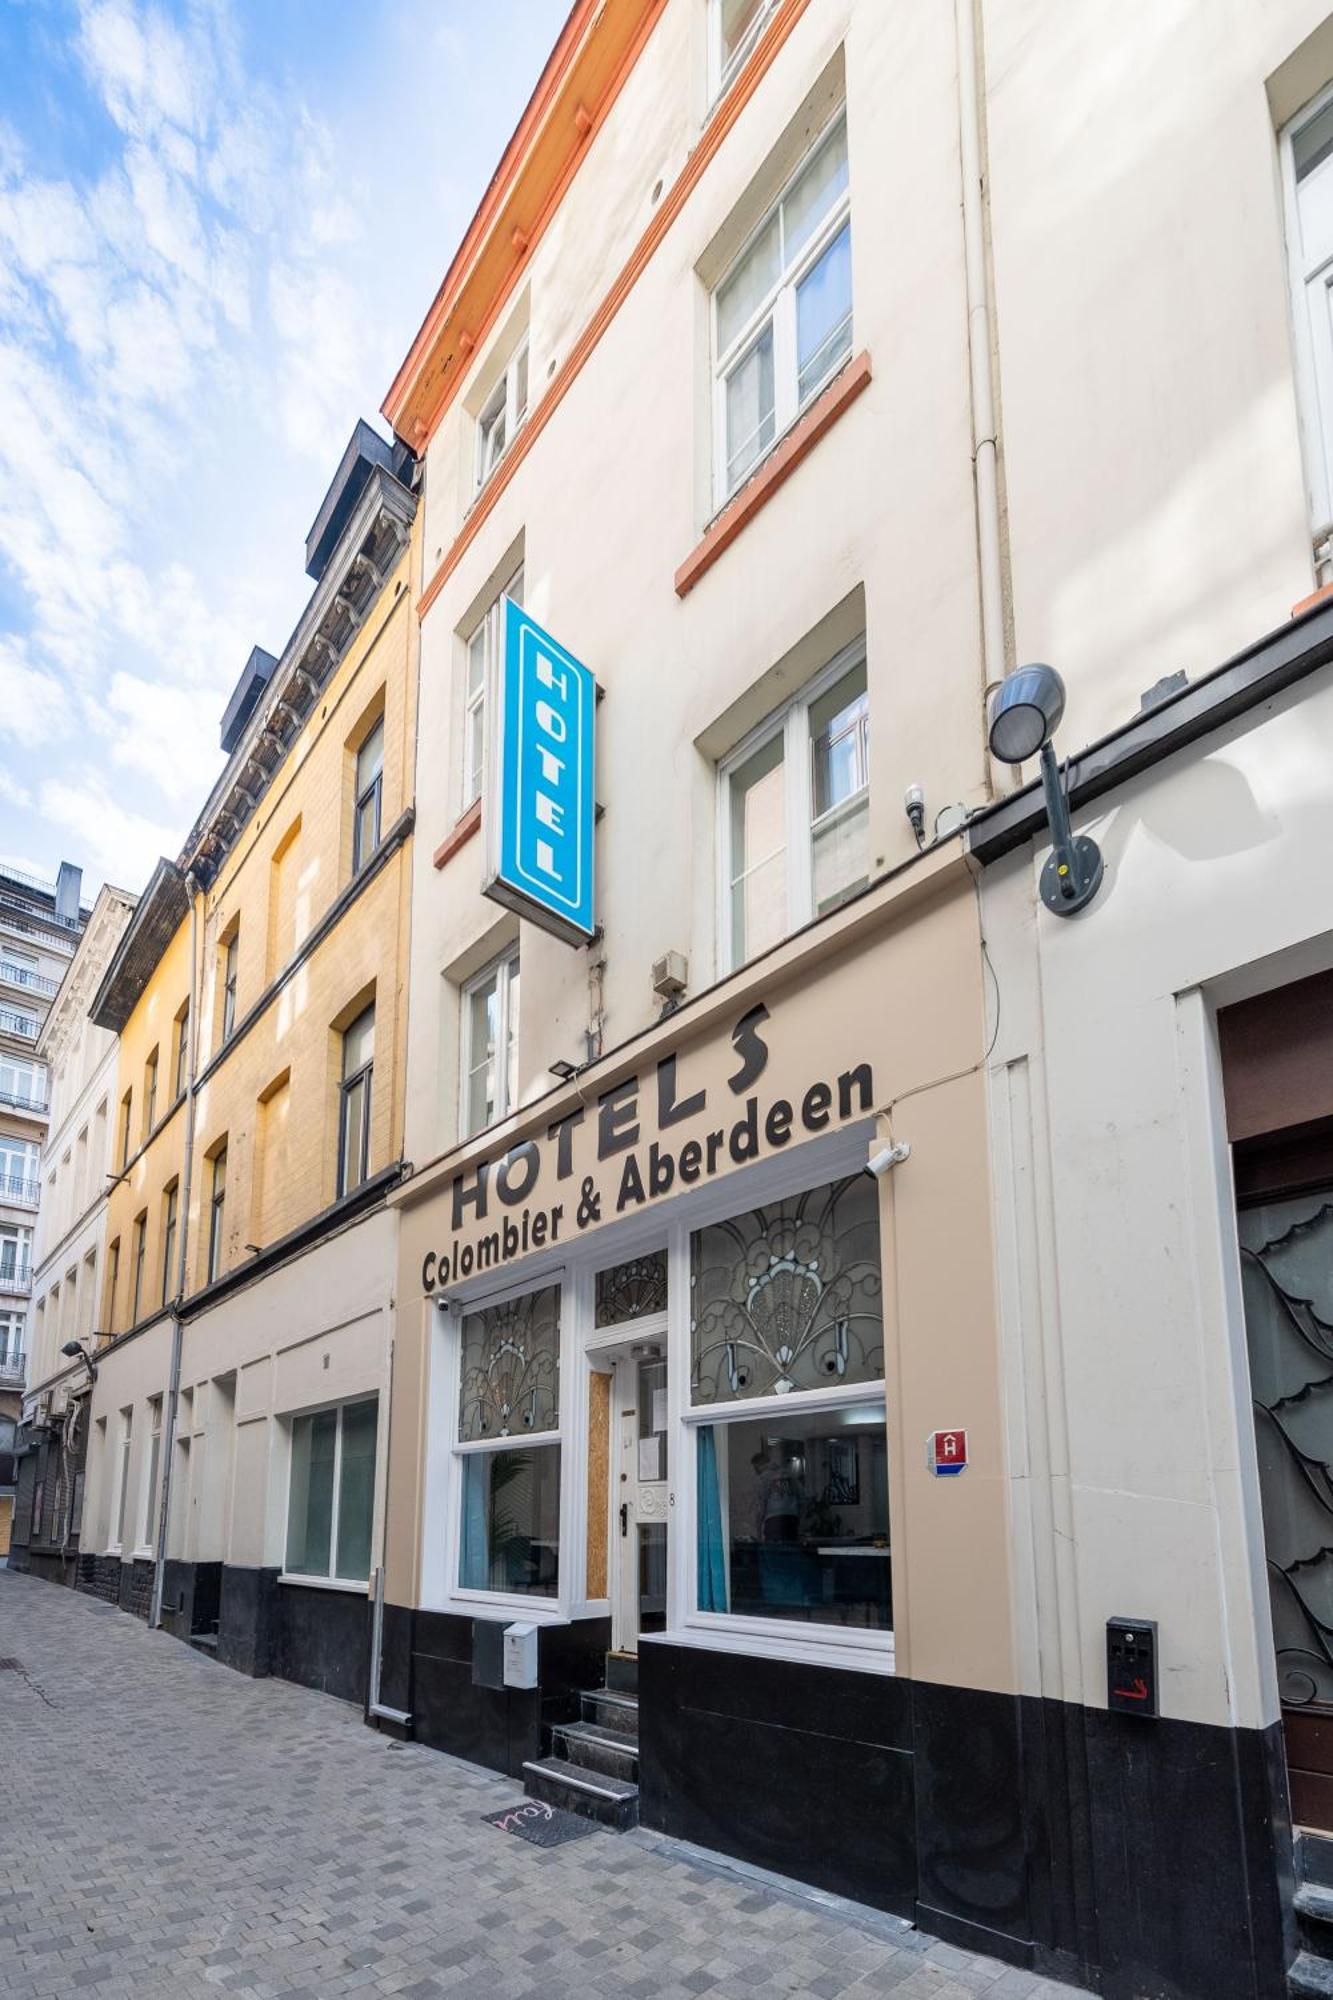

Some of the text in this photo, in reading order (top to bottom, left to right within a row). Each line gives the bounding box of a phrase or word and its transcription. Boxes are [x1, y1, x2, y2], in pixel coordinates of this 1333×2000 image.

[536, 652, 567, 882] HOTEL
[422, 1062, 874, 1293] Colombier & Aberdeen
[451, 1002, 770, 1231] HOTELS
